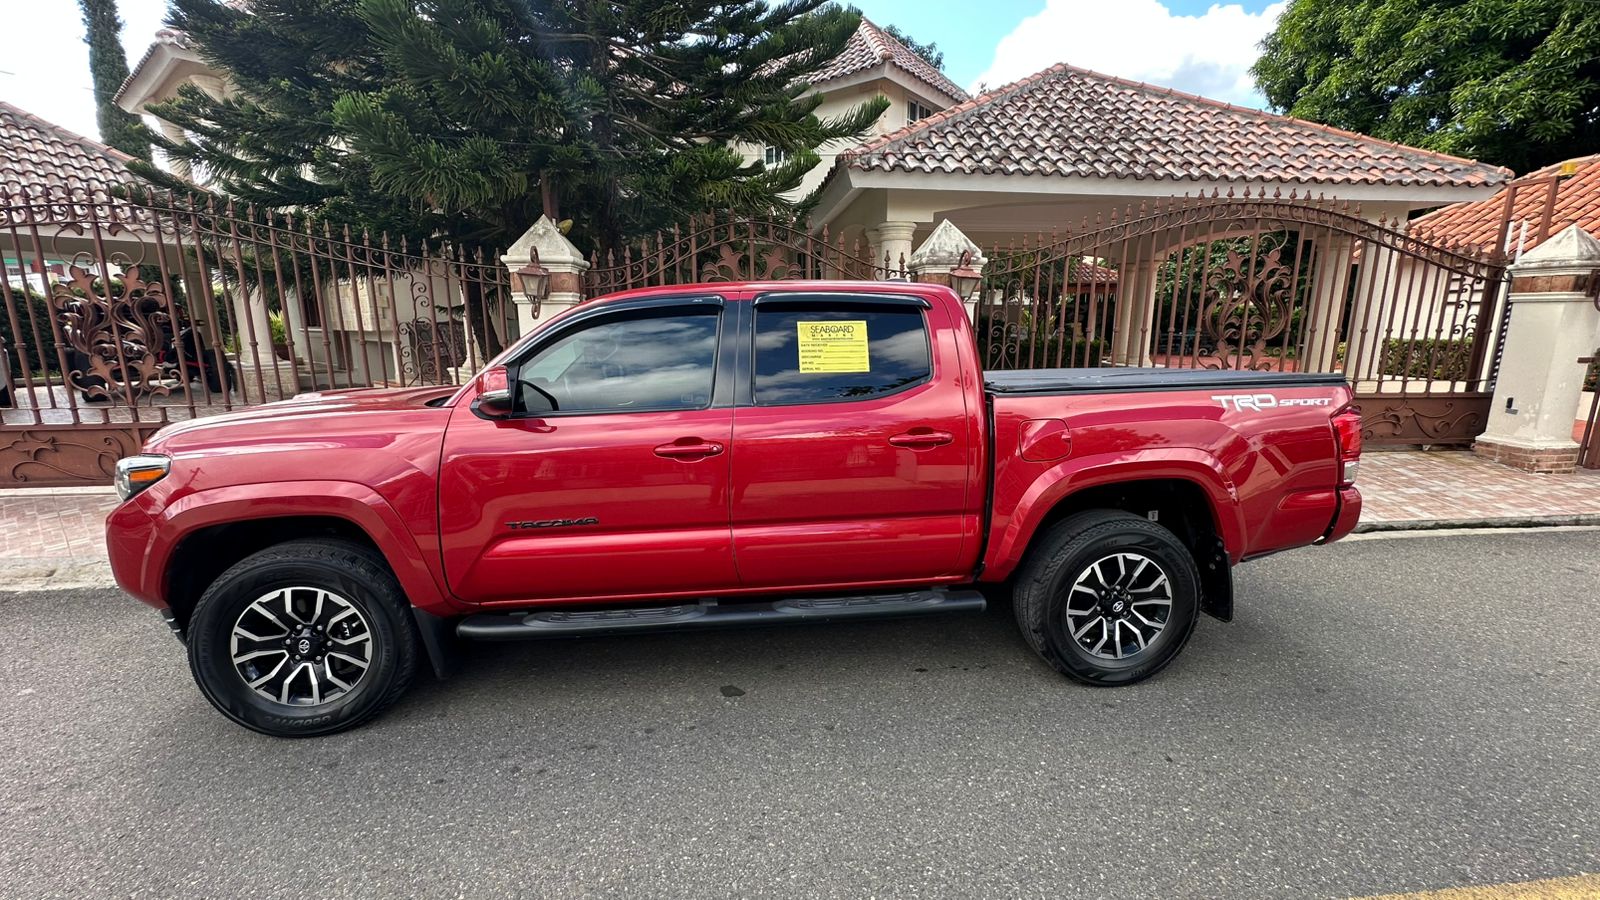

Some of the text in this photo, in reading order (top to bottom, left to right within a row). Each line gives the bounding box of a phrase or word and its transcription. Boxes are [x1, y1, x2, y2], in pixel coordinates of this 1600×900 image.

[810, 325, 854, 334] SEABOARD
[1211, 394, 1333, 412] TRD SPORT
[504, 516, 599, 528] TACOMA
